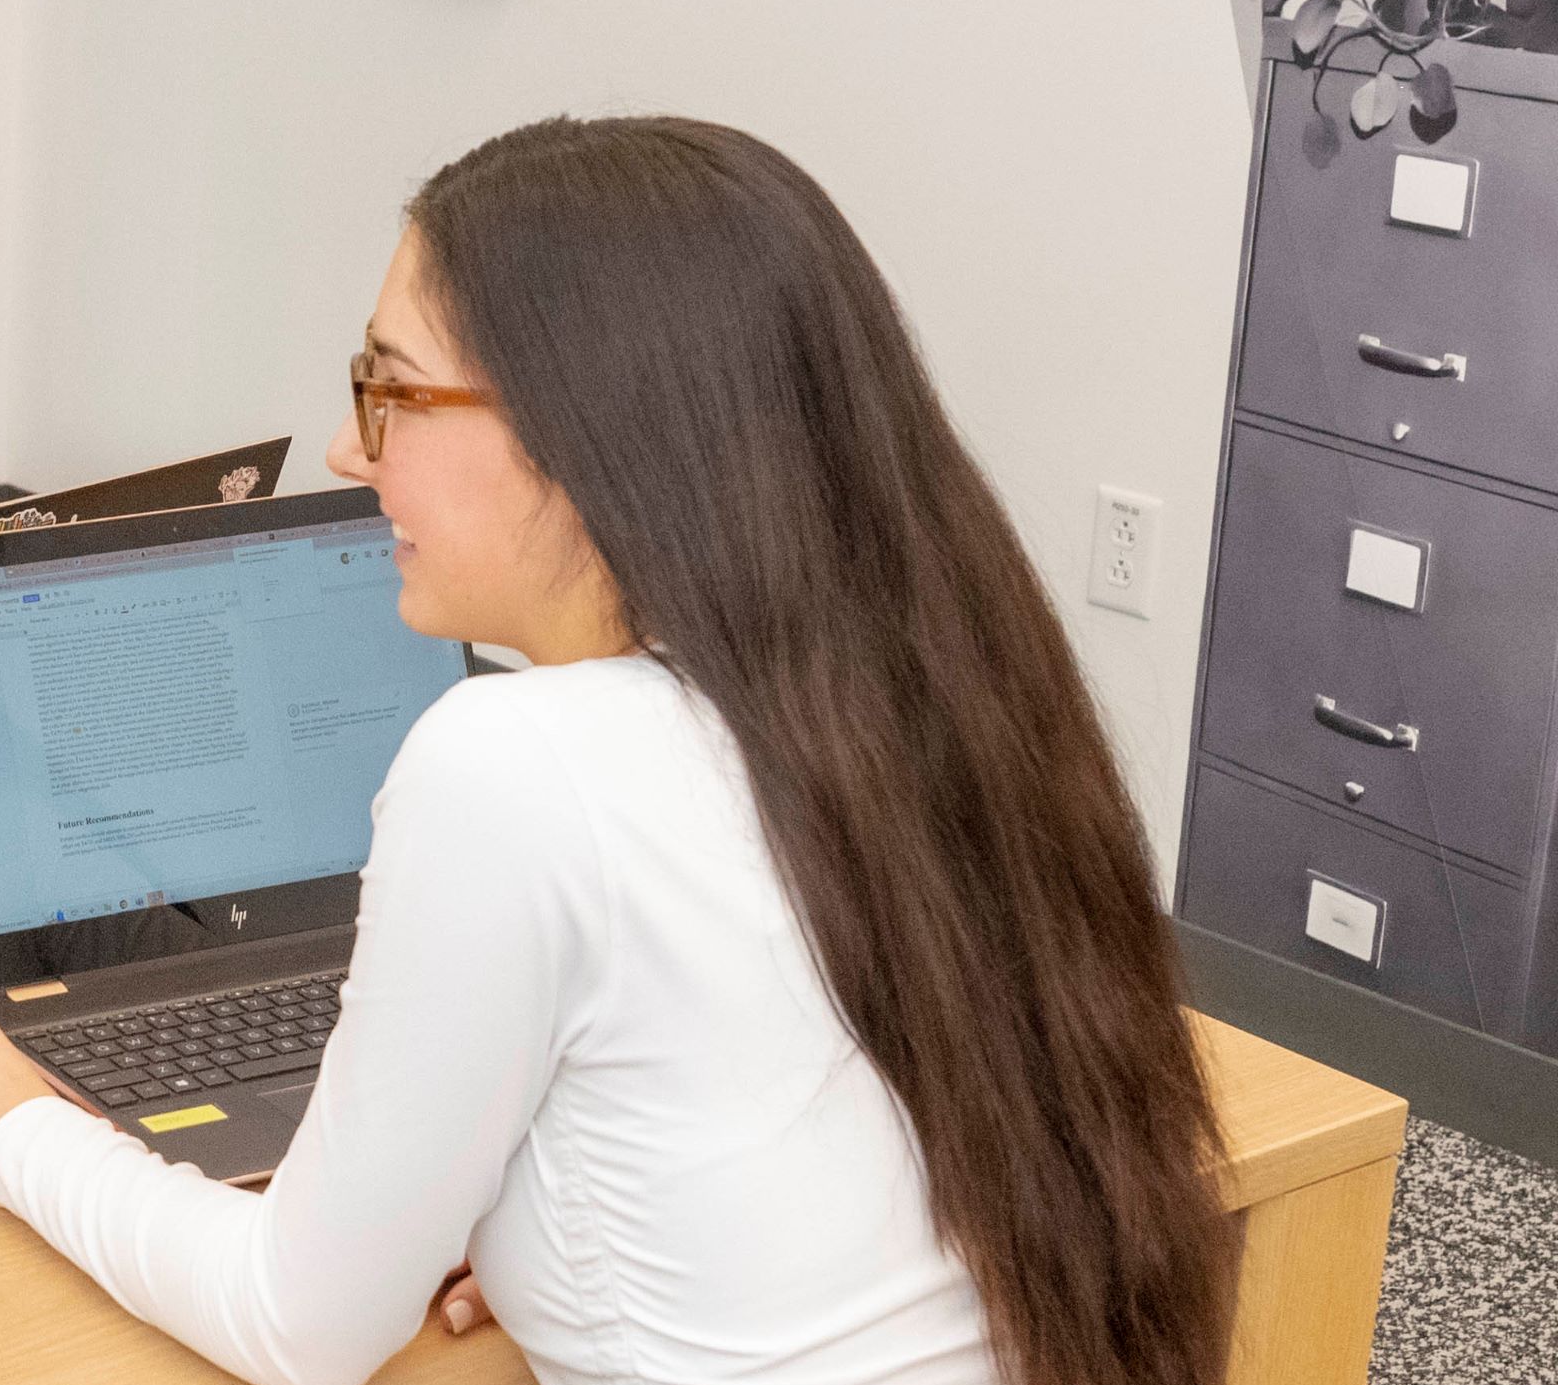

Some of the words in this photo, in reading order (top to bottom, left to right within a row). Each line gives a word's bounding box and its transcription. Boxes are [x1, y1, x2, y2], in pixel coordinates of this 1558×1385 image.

[58, 818, 84, 830] Future
[86, 807, 154, 825] Recommendations
[231, 904, 247, 930] hp
